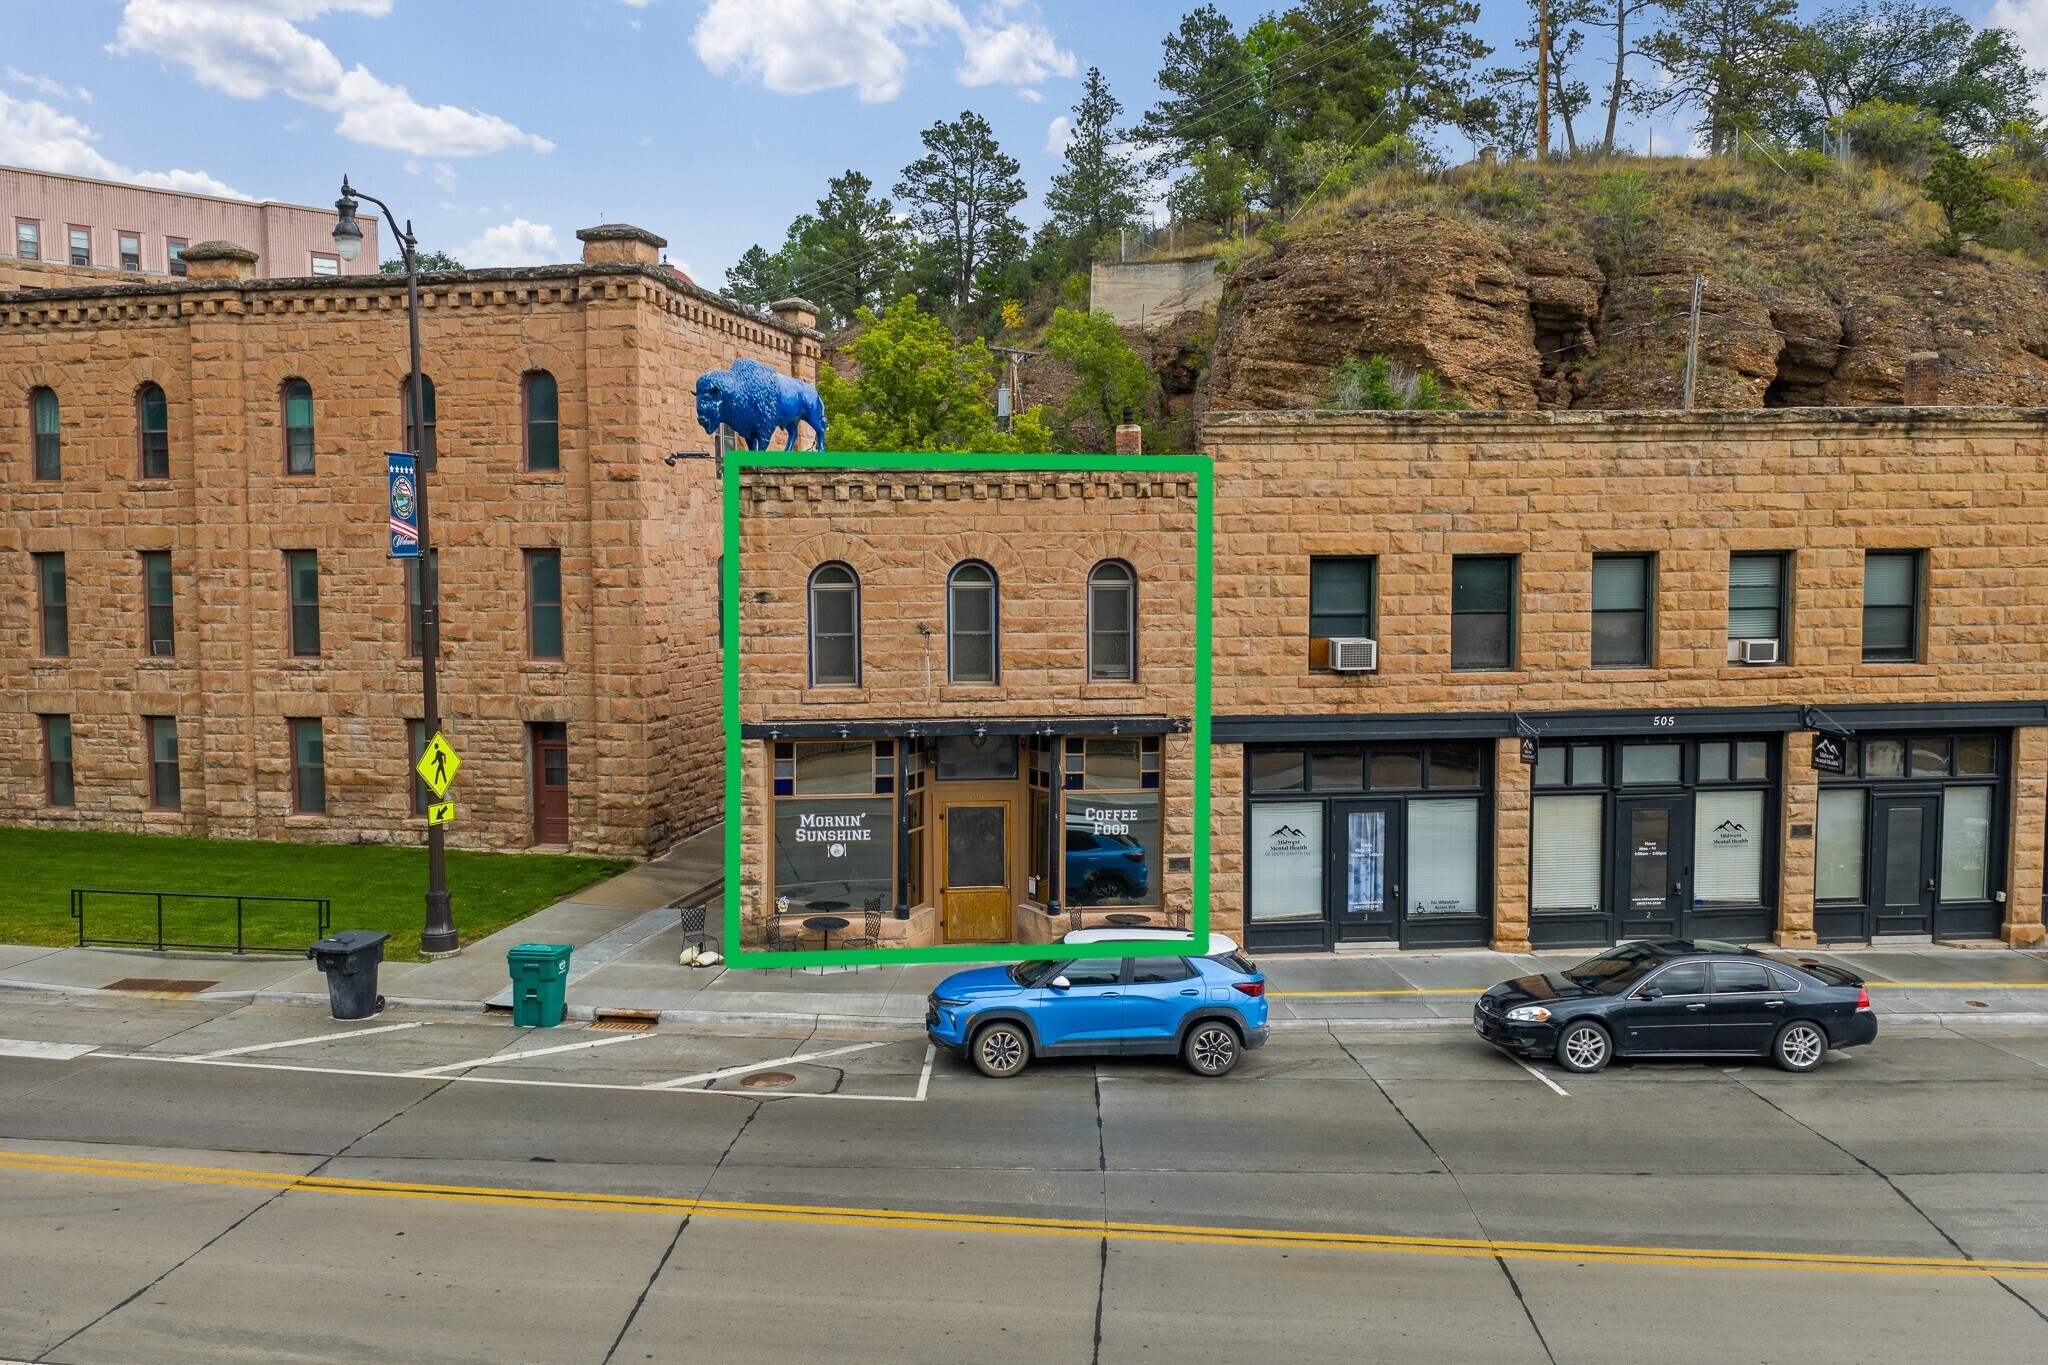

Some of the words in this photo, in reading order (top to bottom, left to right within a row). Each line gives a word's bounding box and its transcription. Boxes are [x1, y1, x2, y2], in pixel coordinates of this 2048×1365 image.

[393, 535, 416, 548] Welcome
[1654, 716, 1674, 726] 505
[1086, 808, 1138, 820] COFFEE
[795, 828, 872, 842] SUNSHINE
[1094, 822, 1129, 836] FOOD
